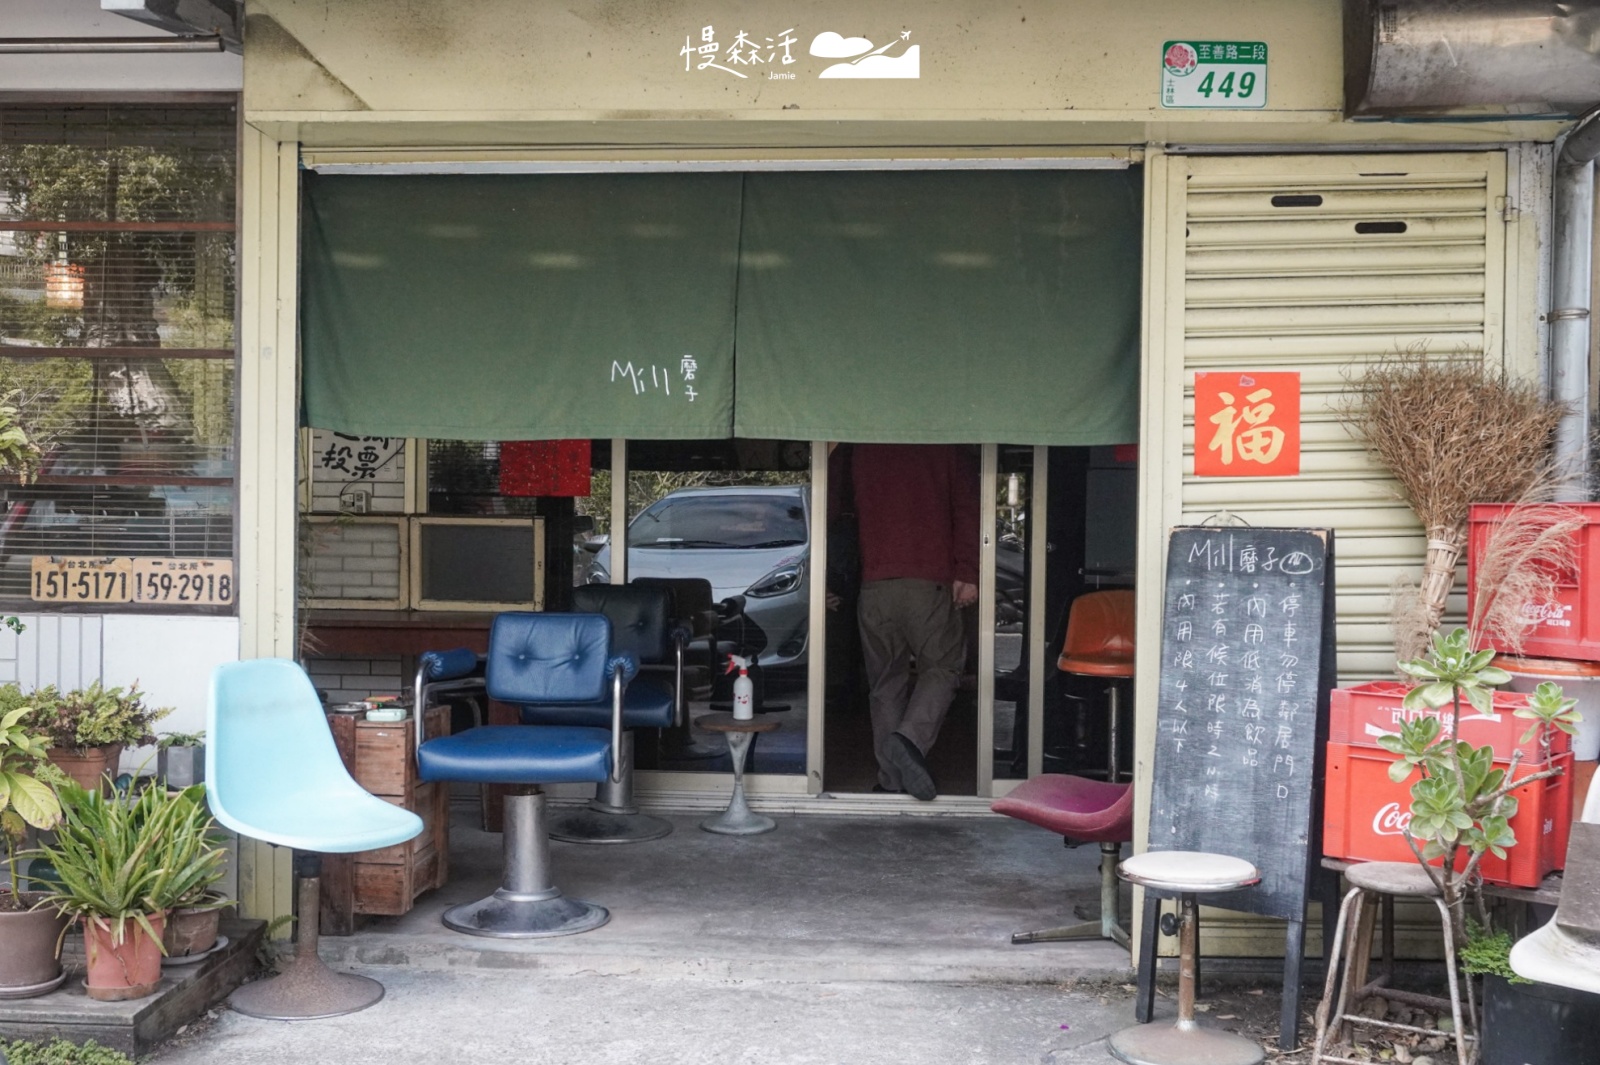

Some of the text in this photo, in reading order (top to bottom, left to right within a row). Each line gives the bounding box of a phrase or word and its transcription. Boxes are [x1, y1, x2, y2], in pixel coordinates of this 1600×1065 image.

[1199, 44, 1265, 60] 至善路二段
[1166, 78, 1175, 104] 士林區
[1197, 71, 1256, 98] 449
[611, 360, 670, 395] Mill
[680, 354, 699, 402] 磨子
[1208, 388, 1285, 465] 福
[322, 443, 379, 479] 投票
[1188, 533, 1279, 573] Mill 磨子
[35, 571, 127, 599] 151-5171
[136, 572, 231, 601] 159-2918
